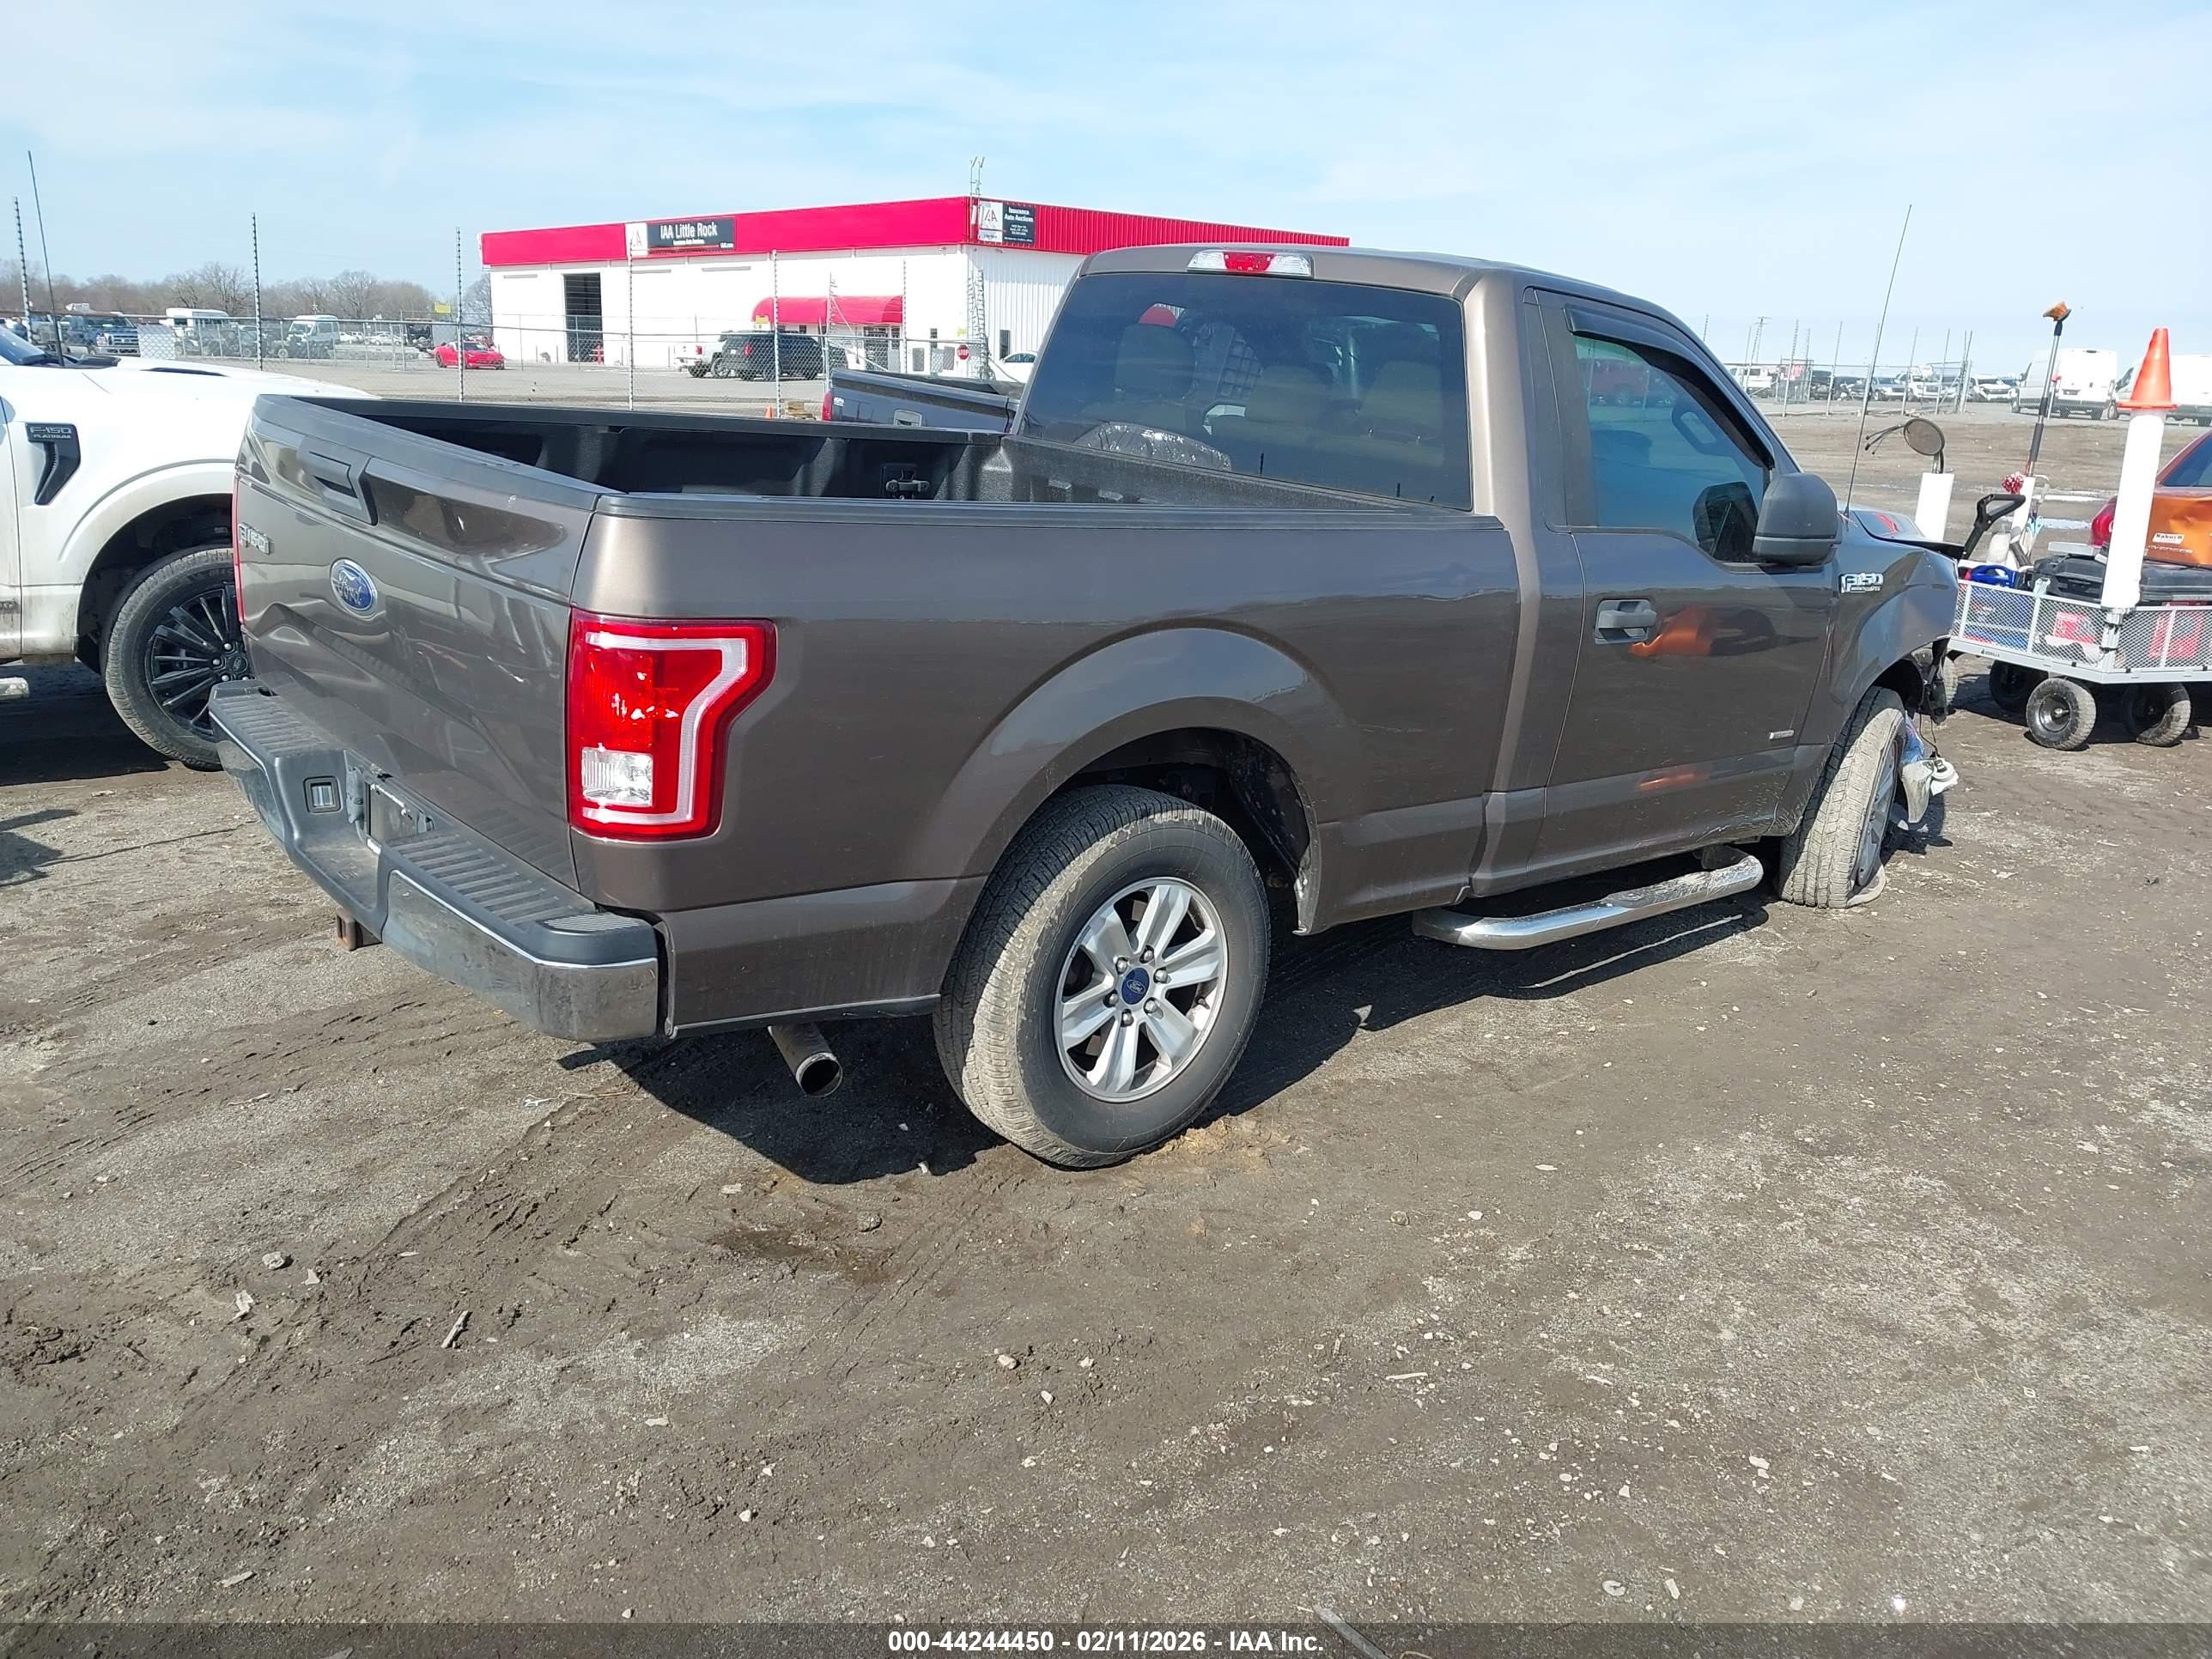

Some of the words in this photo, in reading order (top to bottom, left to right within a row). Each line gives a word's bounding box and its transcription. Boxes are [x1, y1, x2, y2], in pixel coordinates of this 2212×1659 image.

[660, 224, 674, 240] IAA
[675, 223, 696, 239] Little
[696, 221, 718, 237] Rock
[1129, 981, 1143, 993] Ford
